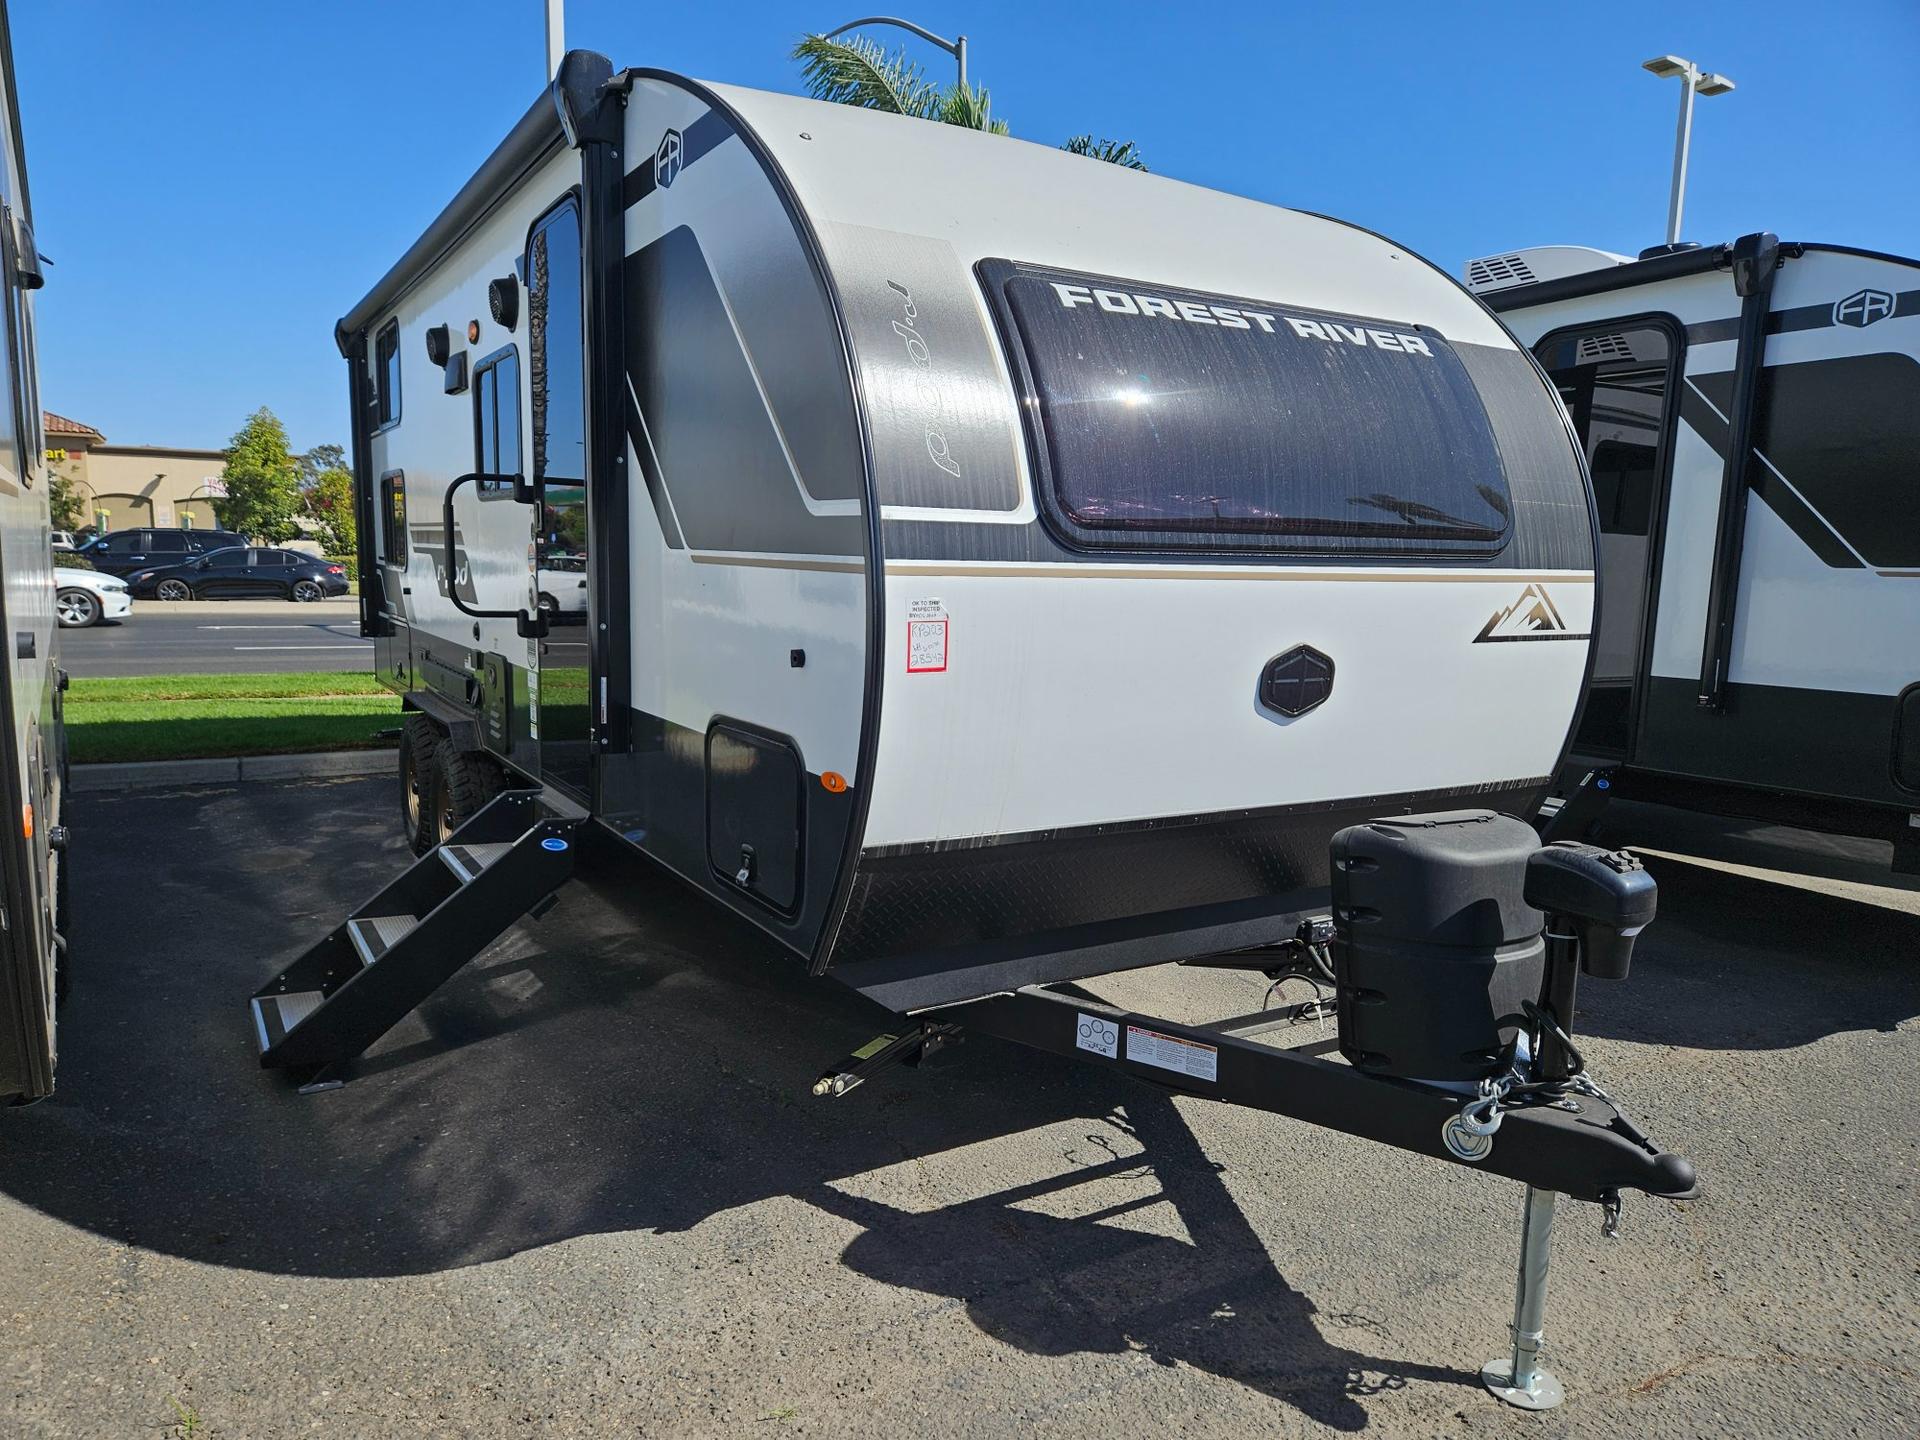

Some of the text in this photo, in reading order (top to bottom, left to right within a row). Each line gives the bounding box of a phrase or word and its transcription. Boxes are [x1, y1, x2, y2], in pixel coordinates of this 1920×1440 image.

[1048, 281, 1435, 358] FOREST RIVER
[1838, 291, 1891, 326] FR
